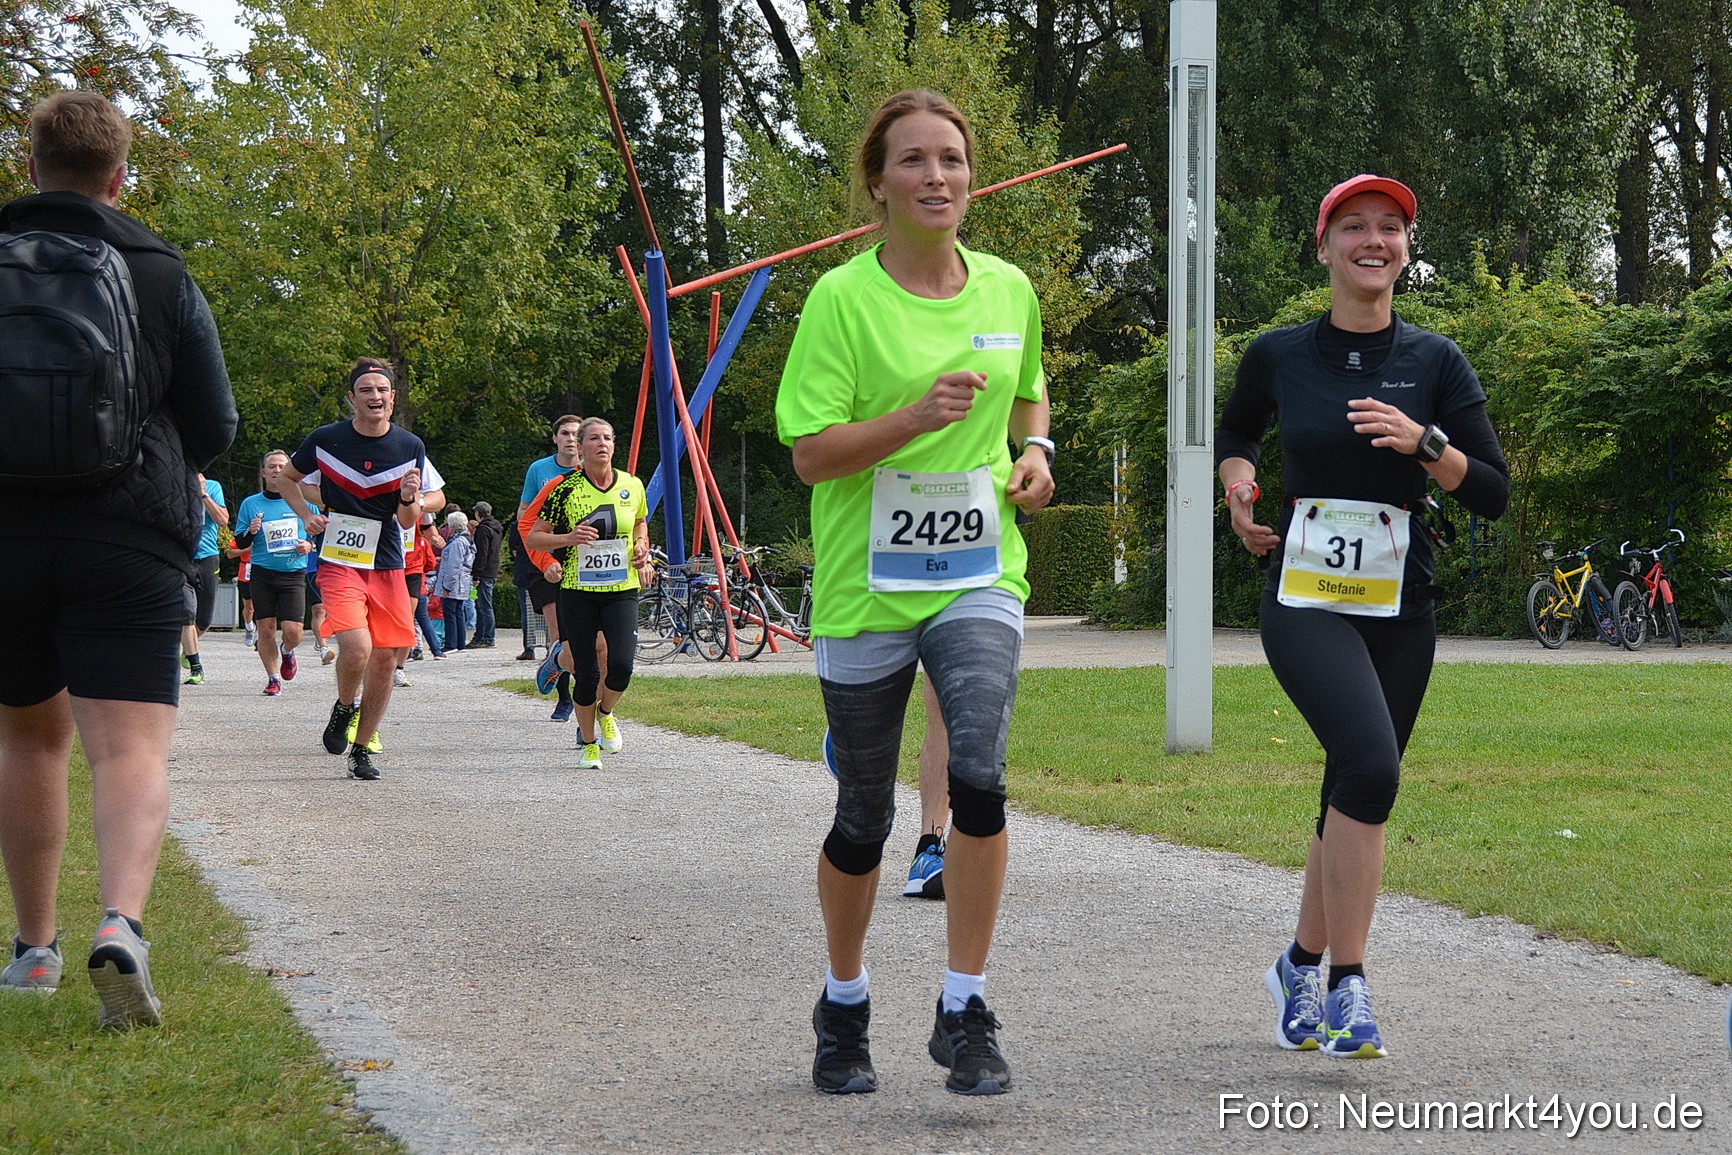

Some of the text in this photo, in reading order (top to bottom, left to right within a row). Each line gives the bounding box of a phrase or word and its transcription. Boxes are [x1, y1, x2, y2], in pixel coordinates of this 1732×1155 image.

[924, 483, 969, 494] BOCK
[1334, 511, 1375, 522] BOCK
[891, 508, 984, 546] 2429
[269, 528, 294, 541] 2922
[336, 529, 366, 549] 280
[337, 550, 360, 559] Michael
[1324, 535, 1363, 571] 31
[584, 553, 621, 569] 2676
[926, 559, 949, 572] Eva
[1317, 579, 1366, 596] Stefanie
